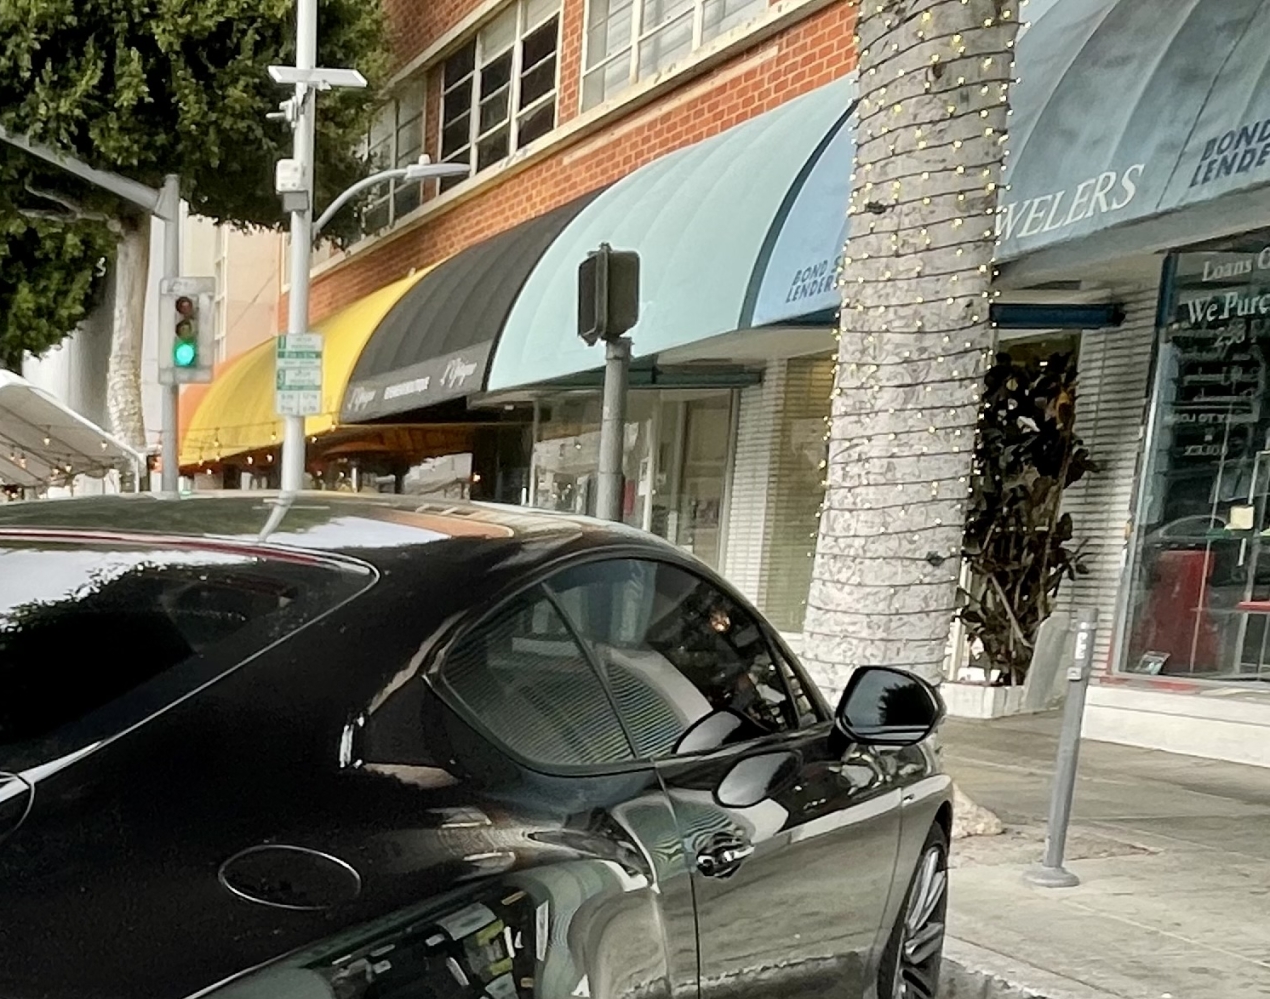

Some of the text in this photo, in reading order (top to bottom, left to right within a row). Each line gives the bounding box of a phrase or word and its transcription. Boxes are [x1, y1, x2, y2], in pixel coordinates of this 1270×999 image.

[792, 259, 828, 286] BOND
[1202, 259, 1252, 282] Loans
[1187, 299, 1218, 324] We
